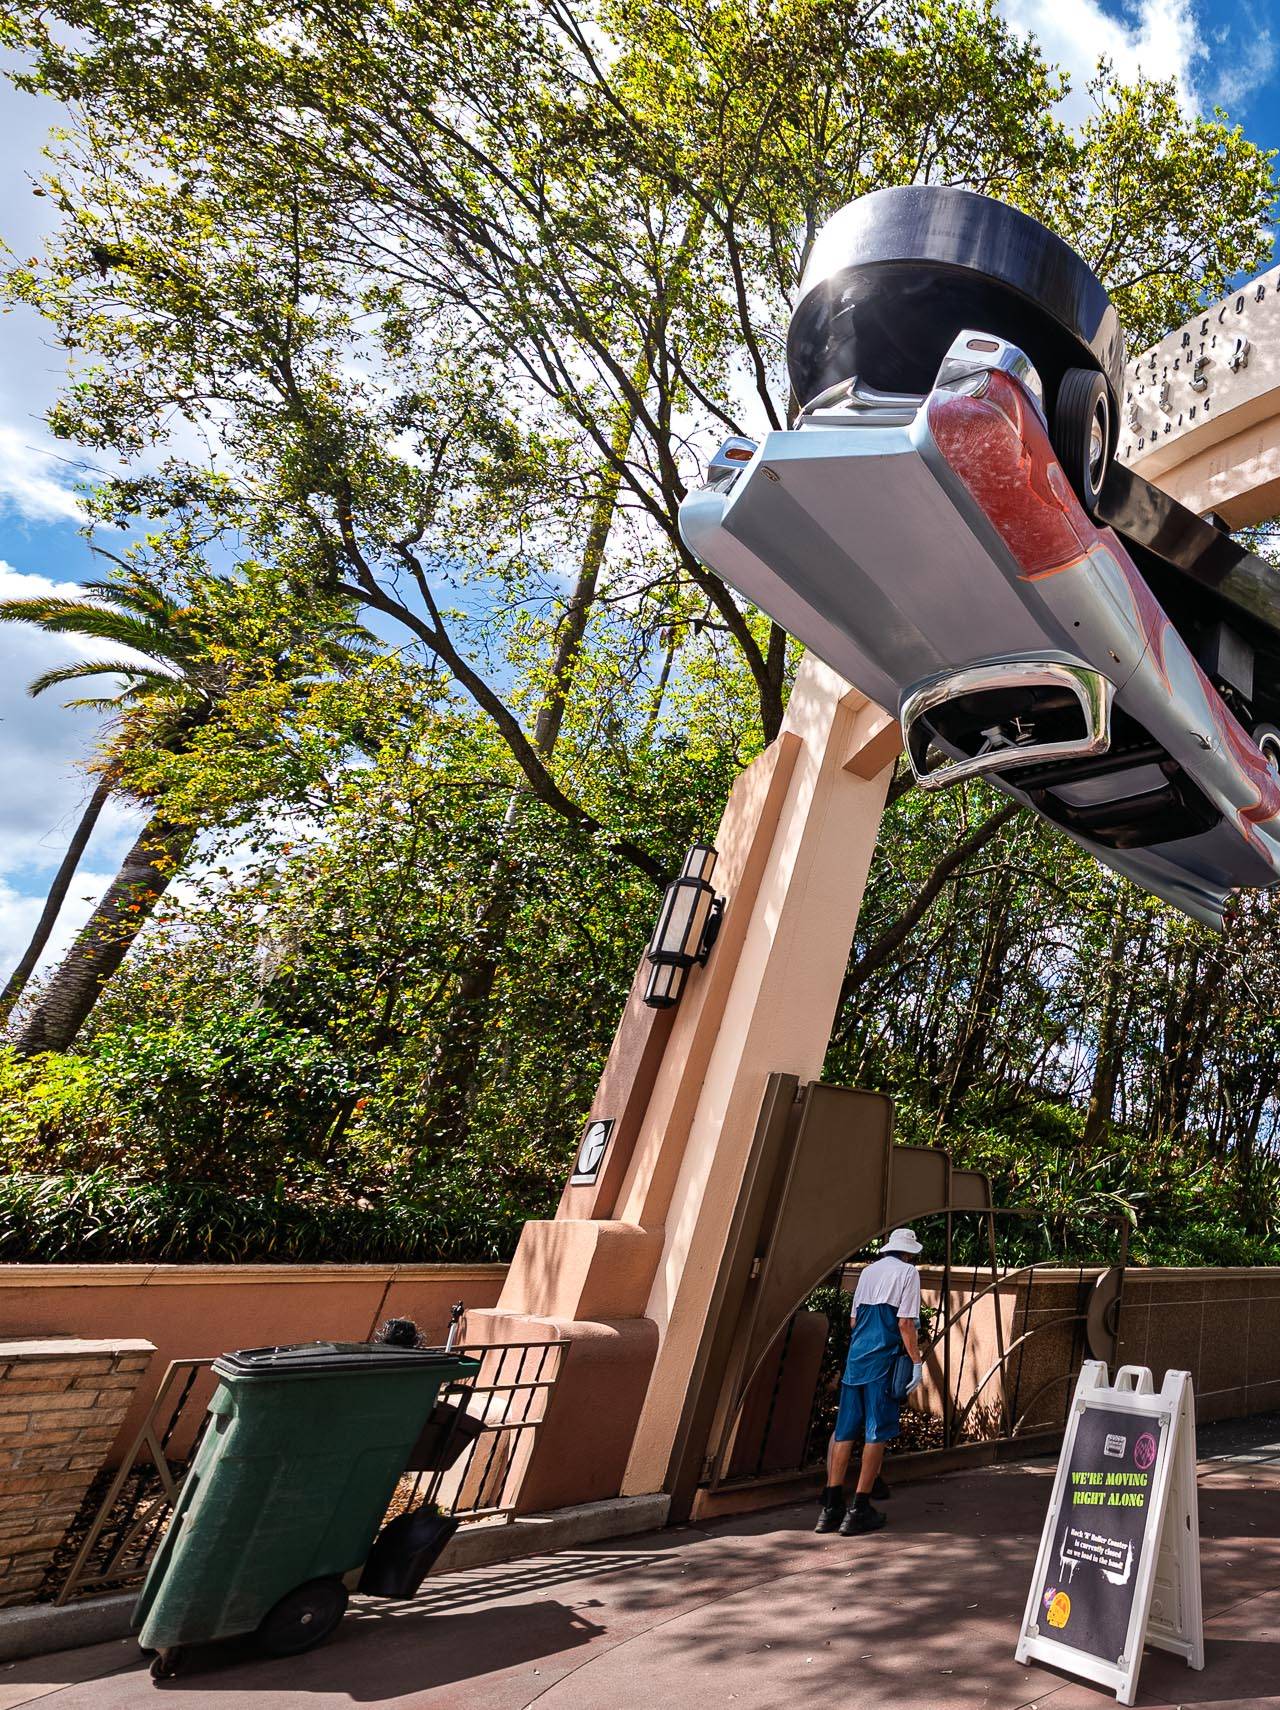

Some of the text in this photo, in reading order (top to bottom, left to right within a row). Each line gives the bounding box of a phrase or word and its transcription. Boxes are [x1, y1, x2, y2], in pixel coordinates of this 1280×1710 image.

[1126, 335, 1217, 404] PRESENTS
[1128, 338, 1249, 433] LLER
[1071, 1471, 1148, 1486] WE'RE MOVING
[1073, 1491, 1144, 1507] RIGHT ALONG
[1074, 1539, 1122, 1558] is currently closed
